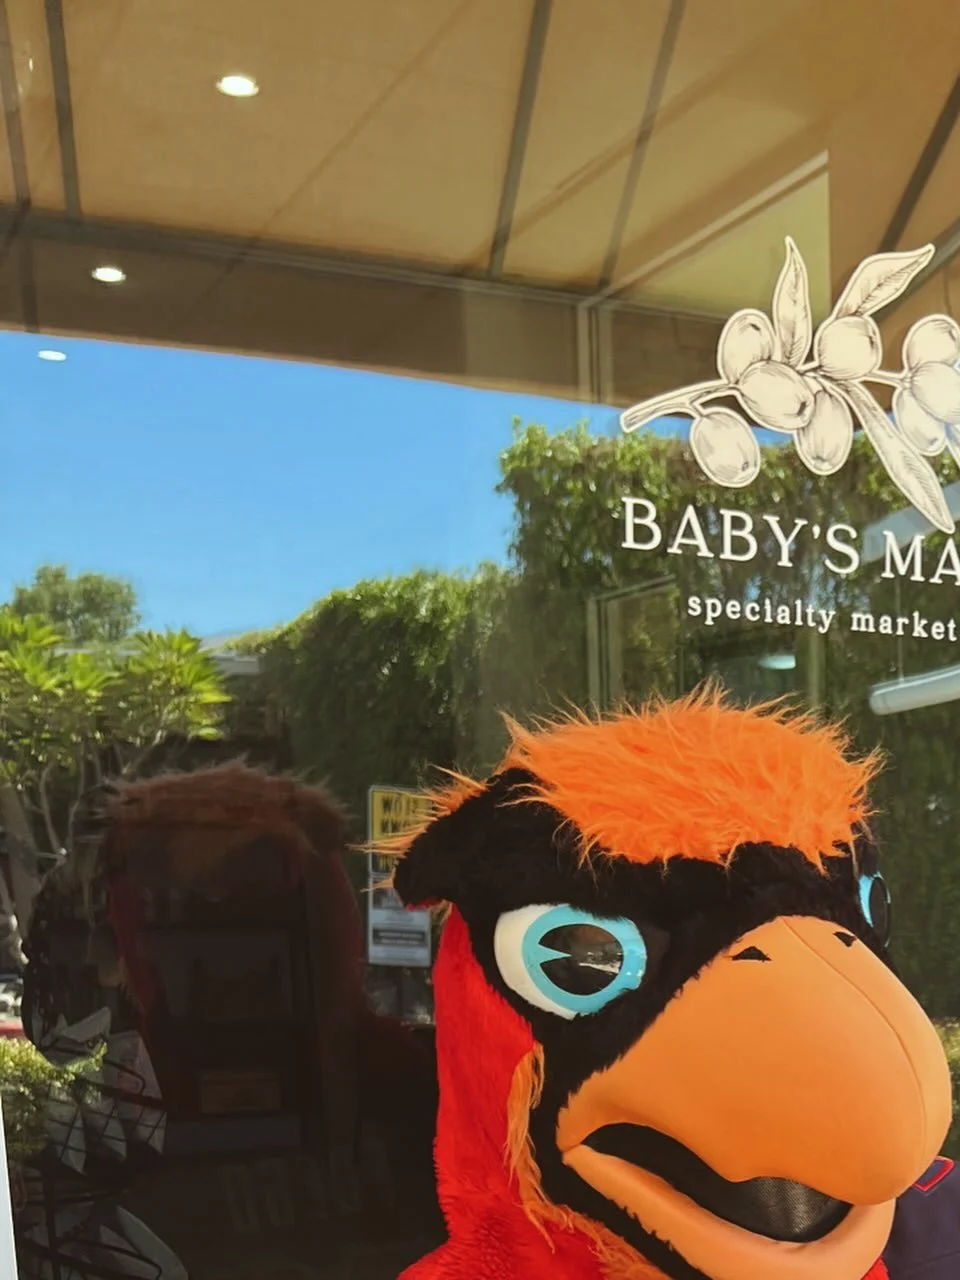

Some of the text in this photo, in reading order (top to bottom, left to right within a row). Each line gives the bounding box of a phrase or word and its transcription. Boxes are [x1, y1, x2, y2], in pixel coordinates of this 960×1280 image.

[621, 496, 861, 575] BABY'S
[687, 595, 836, 634] specialty
[851, 612, 957, 642] market
